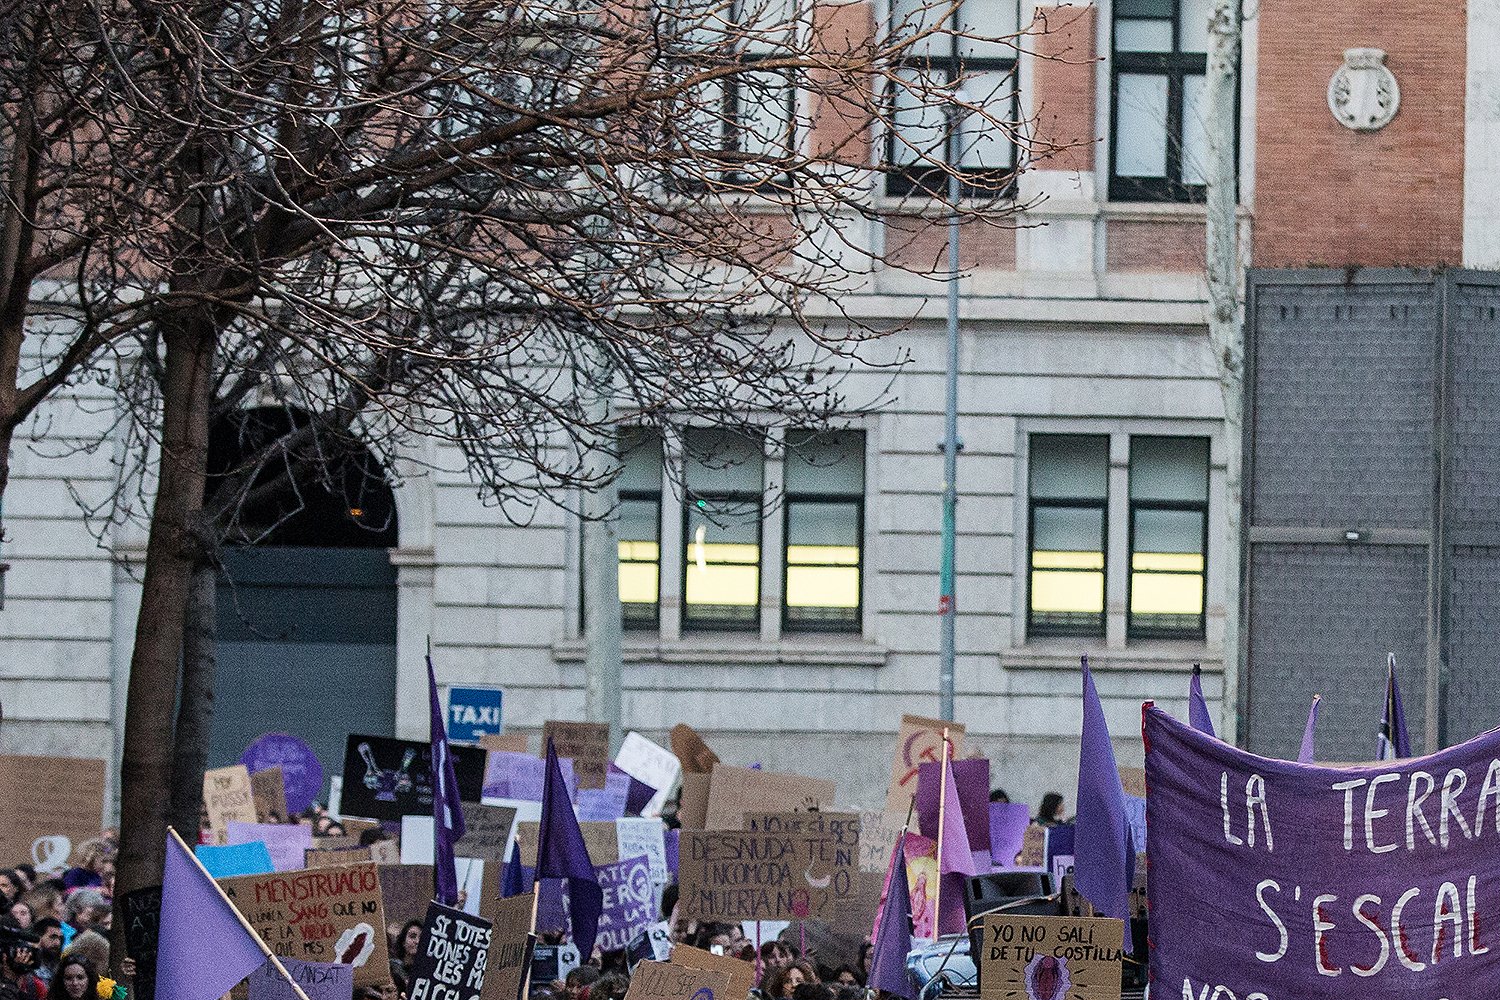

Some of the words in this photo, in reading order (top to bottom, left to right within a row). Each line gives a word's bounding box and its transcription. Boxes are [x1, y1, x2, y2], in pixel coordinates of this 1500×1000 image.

[452, 704, 500, 726] TAXI
[1220, 770, 1273, 852] LA
[691, 836, 796, 861] DESNUDA
[253, 864, 378, 904] MENSTRUACIÓ
[703, 862, 794, 888] INCOMODA
[288, 900, 328, 925] SANG
[332, 903, 357, 917] QUE
[361, 901, 378, 915] NO
[279, 926, 294, 939] LA
[431, 915, 451, 938] SI
[455, 919, 493, 949] TOTES
[992, 924, 1014, 943] YO
[1021, 925, 1047, 943] NO
[1057, 924, 1095, 944] SALÍ
[426, 936, 472, 964] DONES
[474, 950, 488, 970] B
[991, 946, 1010, 961] DE
[1014, 946, 1036, 963] TU
[433, 960, 464, 986] LES
[466, 968, 485, 991] M
